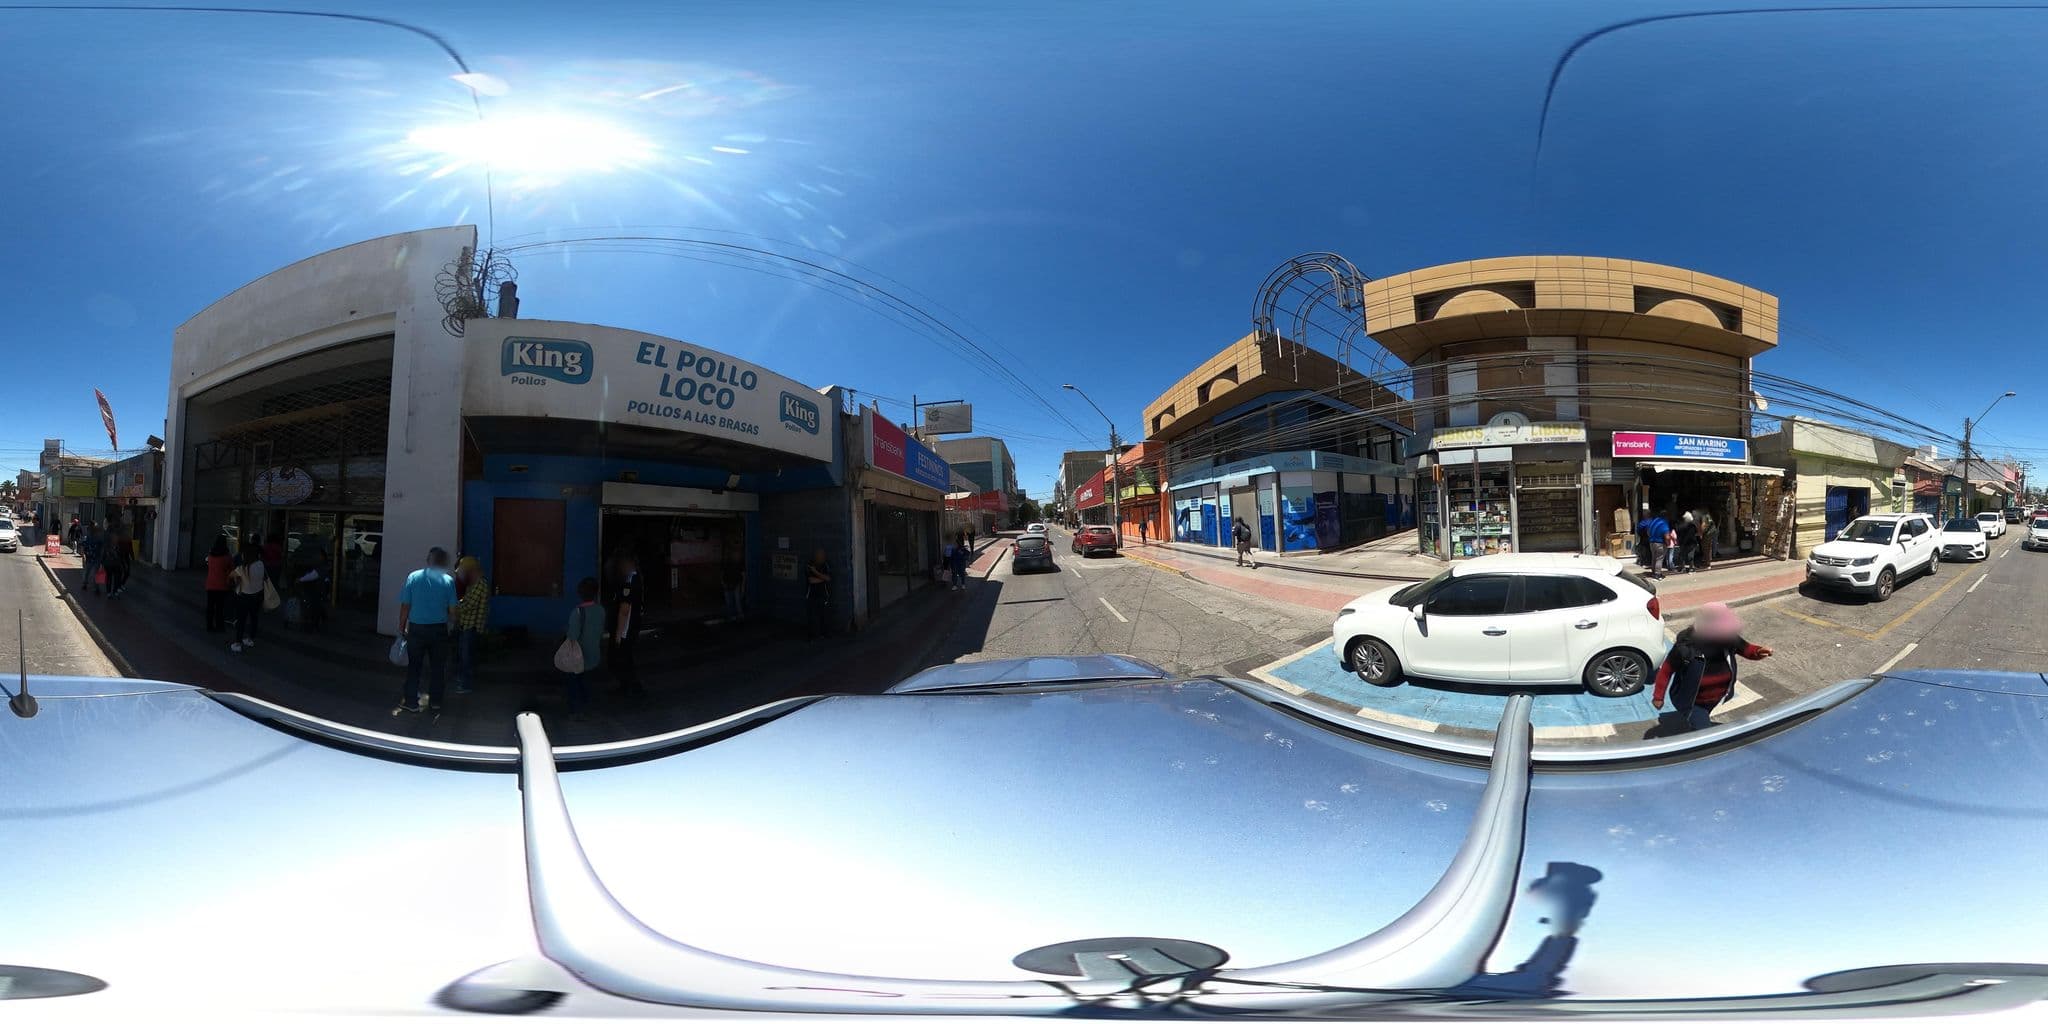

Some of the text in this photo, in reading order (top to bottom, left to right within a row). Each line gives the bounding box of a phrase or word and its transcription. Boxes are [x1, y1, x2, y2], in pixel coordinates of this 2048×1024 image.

[512, 342, 583, 375] King
[636, 341, 758, 391] EL POLLO
[511, 375, 547, 386] Pollos
[659, 373, 735, 410] LOCO
[627, 400, 760, 435] POLLOS A LAS BRASAS
[785, 397, 815, 428] King
[1531, 423, 1582, 436] LIBROS
[1678, 437, 1728, 448] SAN MARINO
